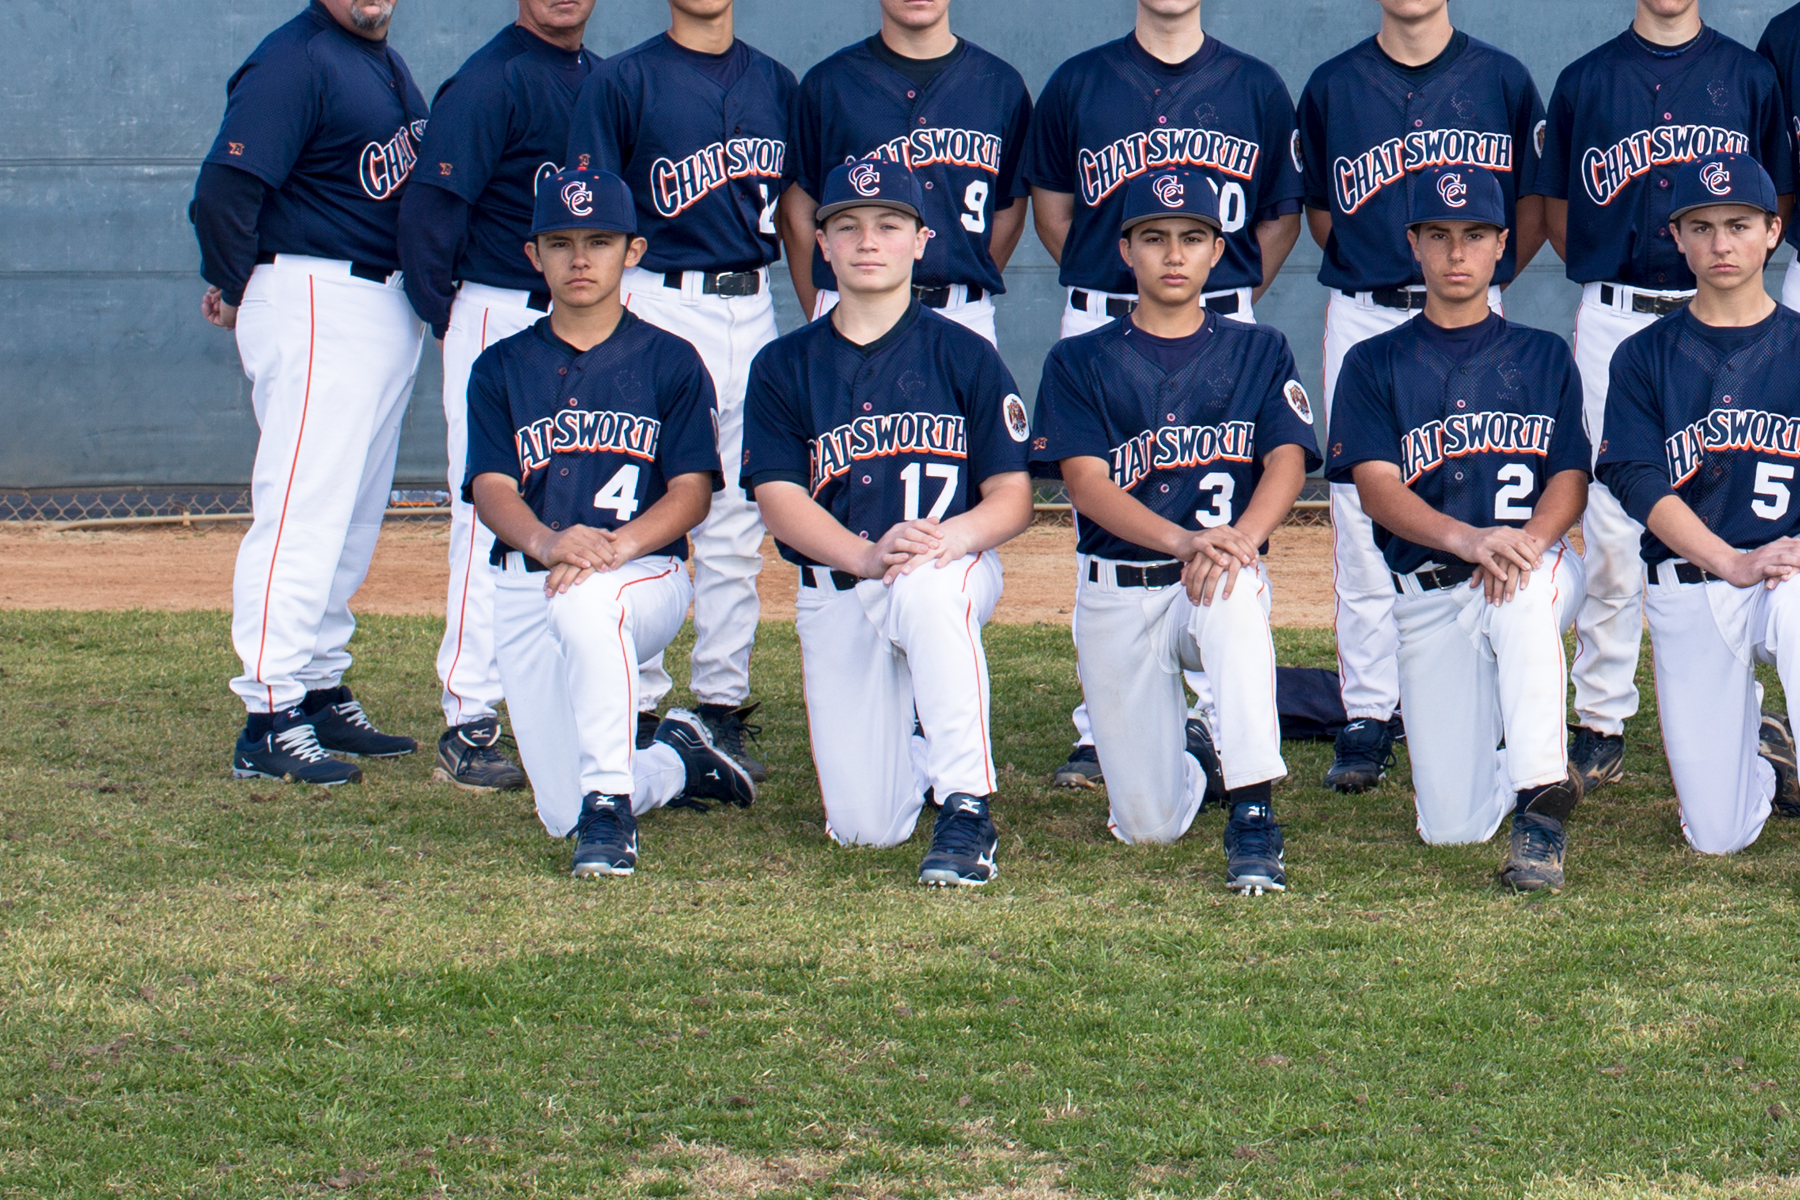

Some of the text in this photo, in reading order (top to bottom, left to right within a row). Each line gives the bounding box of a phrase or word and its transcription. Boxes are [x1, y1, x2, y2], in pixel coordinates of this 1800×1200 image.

[1079, 128, 1259, 206] CHATSWORTH
[1333, 128, 1512, 214] CHATSWORTH
[959, 179, 990, 234] 9
[514, 409, 661, 497] ATSWORTH
[594, 463, 640, 521] 4
[899, 462, 959, 520] 17
[1195, 472, 1236, 528] 3
[1494, 463, 1534, 520] 2
[1750, 461, 1795, 520] 5
